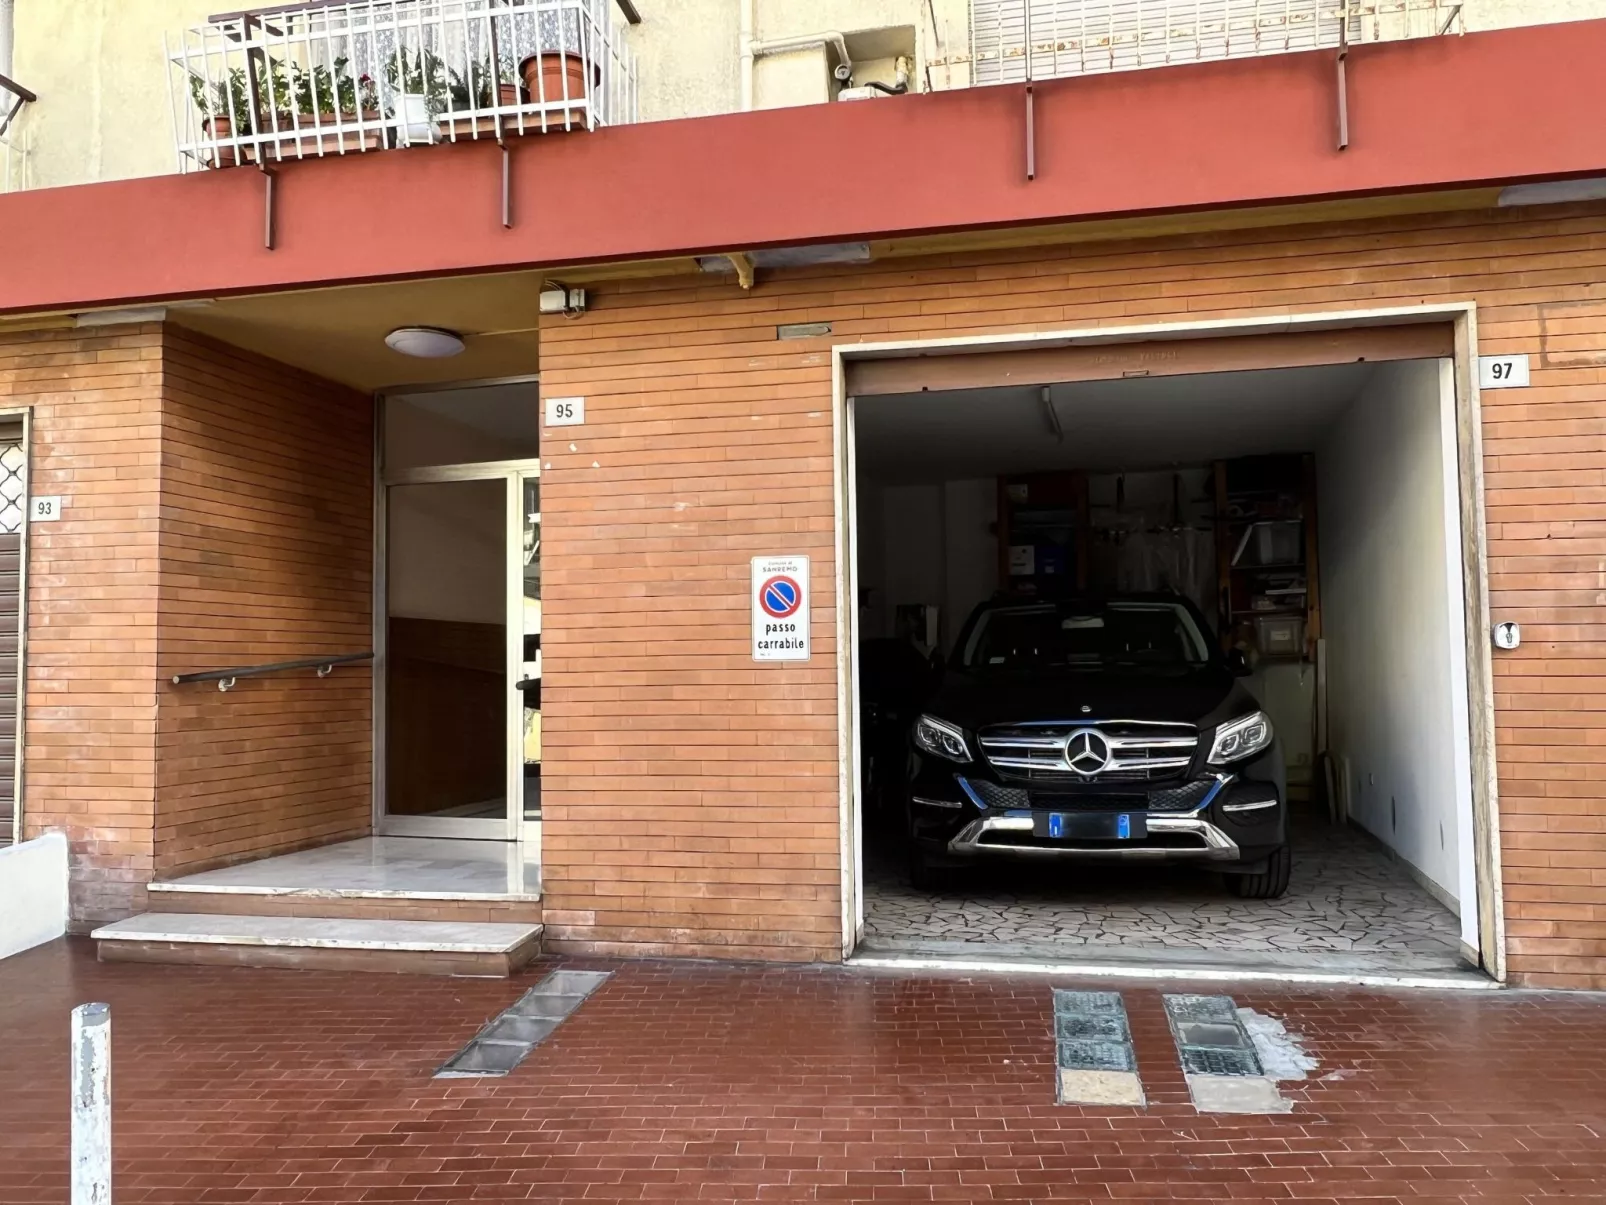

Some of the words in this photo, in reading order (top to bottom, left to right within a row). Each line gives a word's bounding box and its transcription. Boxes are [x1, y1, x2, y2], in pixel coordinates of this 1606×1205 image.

[1492, 362, 1513, 379] 97
[556, 403, 573, 418] 95
[38, 501, 52, 515] 93
[766, 624, 796, 636] passo
[758, 638, 804, 648] carrabile
